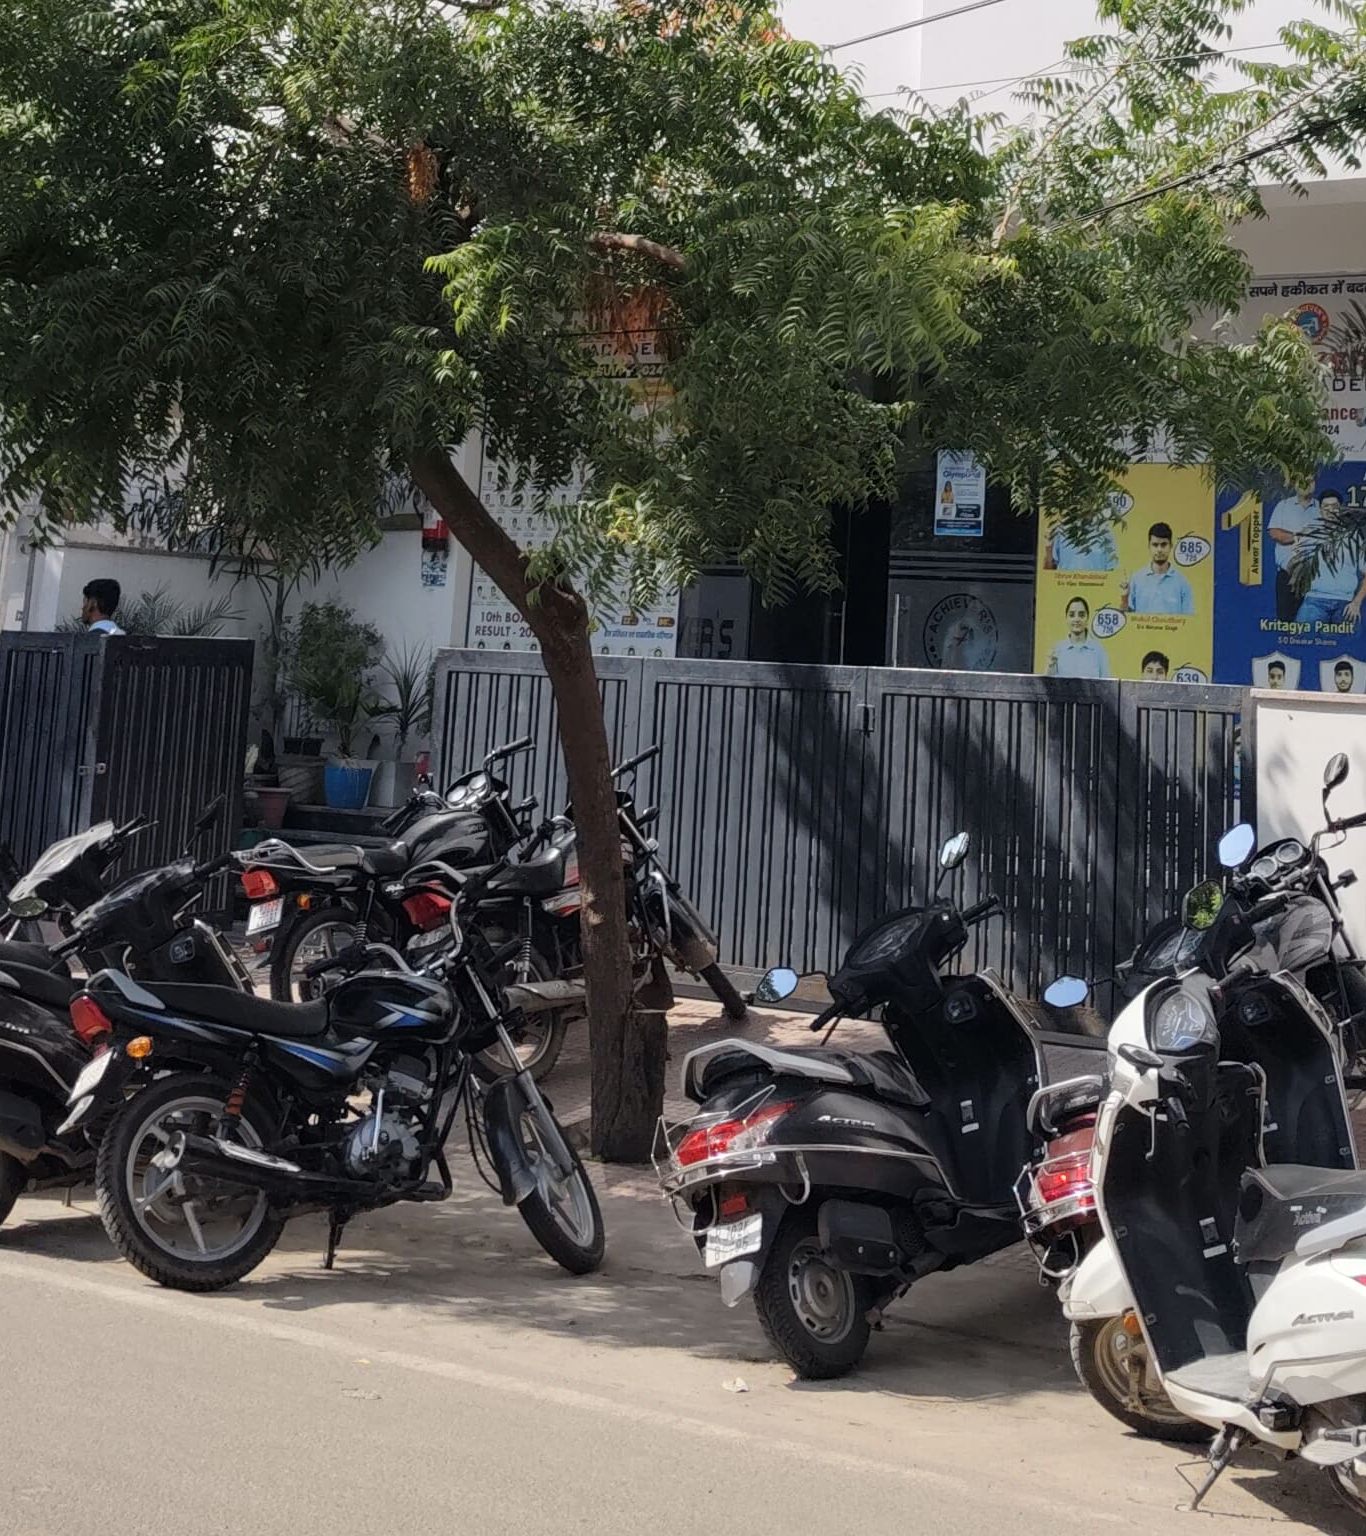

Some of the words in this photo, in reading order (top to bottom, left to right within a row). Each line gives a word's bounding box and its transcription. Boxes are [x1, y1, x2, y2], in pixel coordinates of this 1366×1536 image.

[1249, 281, 1278, 297] सपने
[1281, 280, 1328, 297] हकीकत
[1332, 280, 1345, 294] में
[1251, 511, 1262, 546] Topper
[1180, 541, 1203, 554] 685
[481, 611, 503, 623] 10th
[1097, 613, 1119, 625] 658
[474, 625, 511, 638] RESULT
[1259, 618, 1311, 635] Kritagya
[1314, 620, 1356, 634] Pandit
